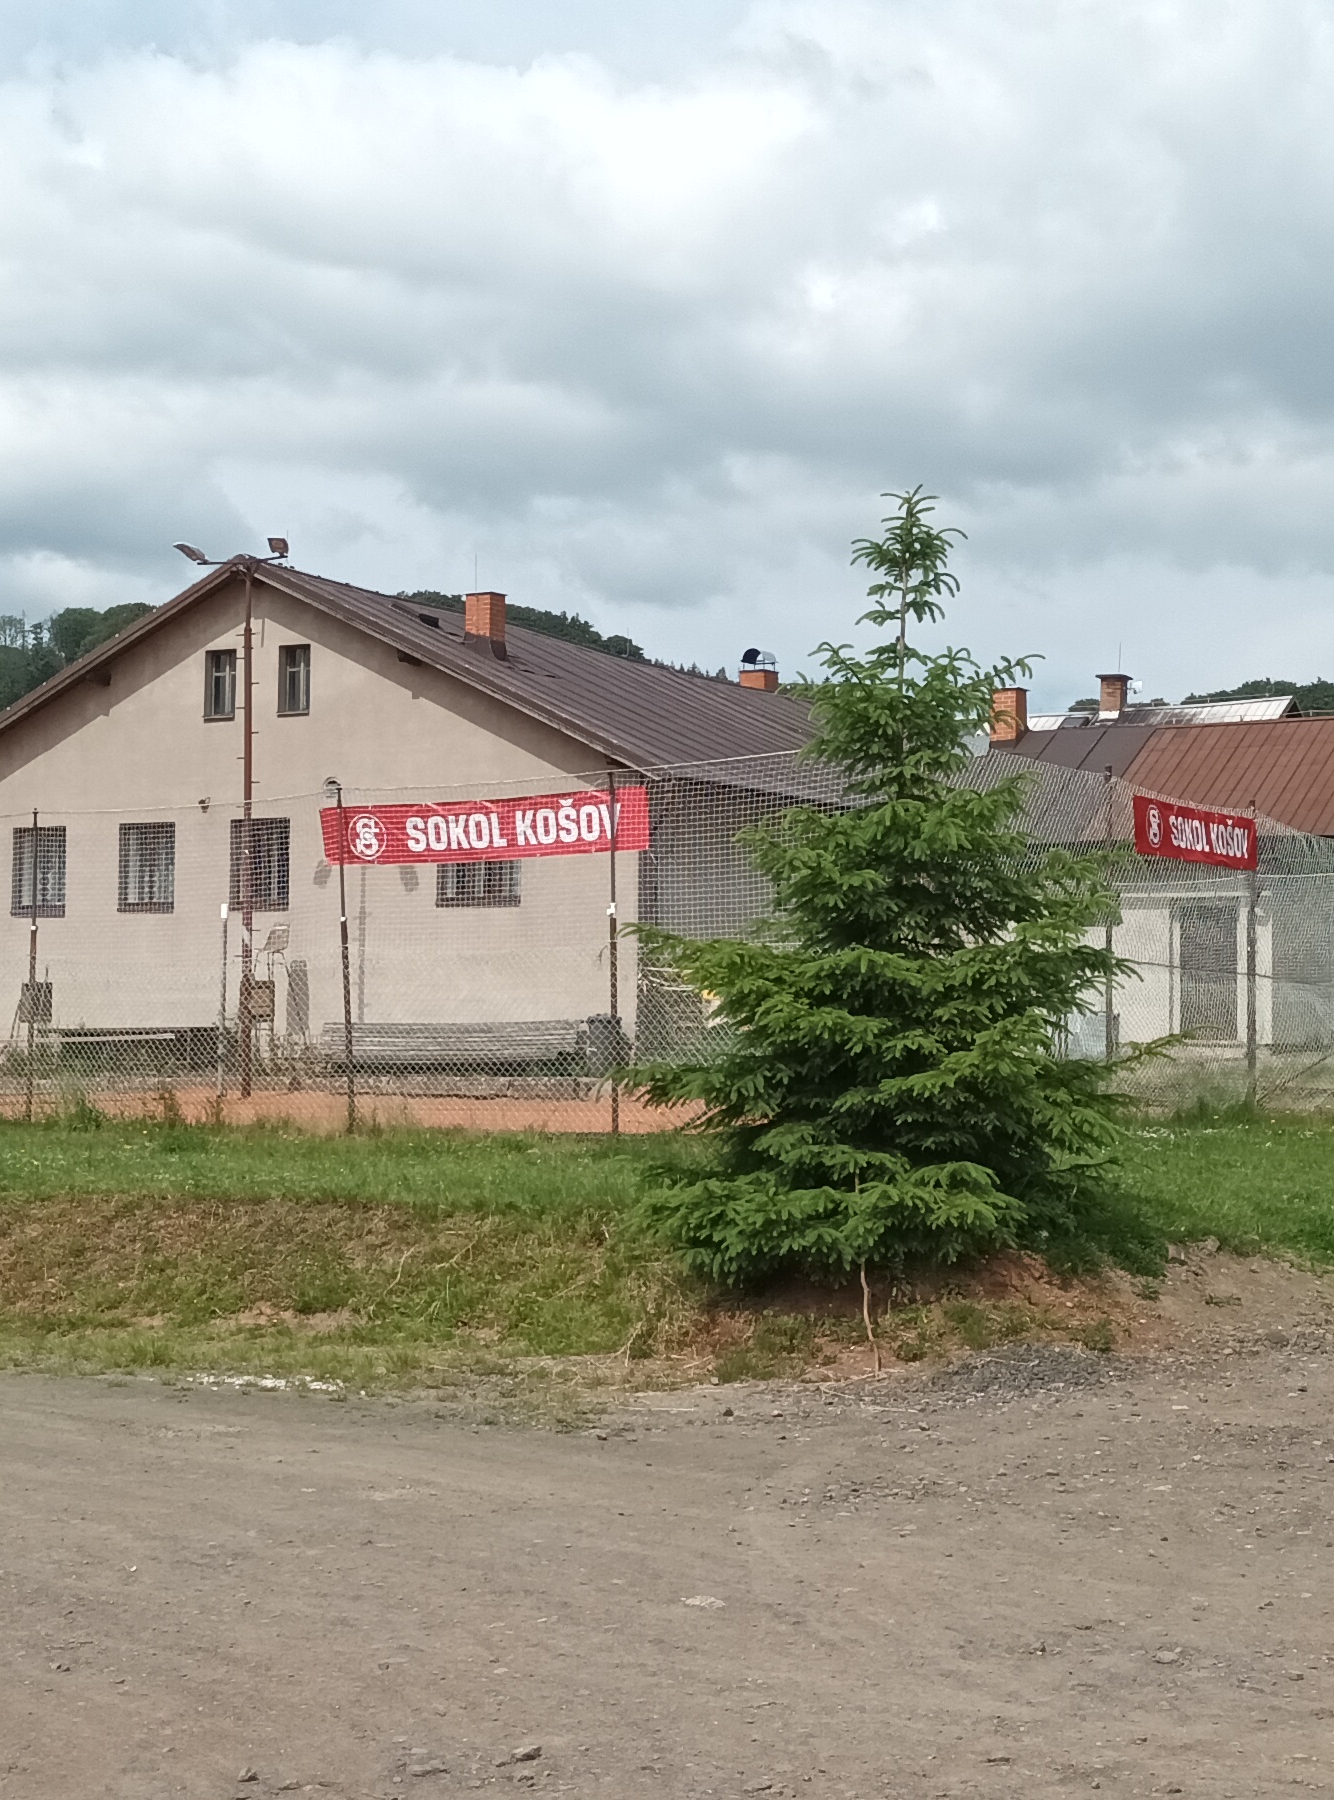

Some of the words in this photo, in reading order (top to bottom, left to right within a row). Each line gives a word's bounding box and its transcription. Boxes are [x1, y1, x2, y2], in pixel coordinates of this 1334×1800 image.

[405, 812, 507, 852] SOKOL
[517, 799, 621, 845] KOŠOV
[1169, 815, 1210, 852] SOKOL
[1210, 819, 1248, 859] KOŠOV
